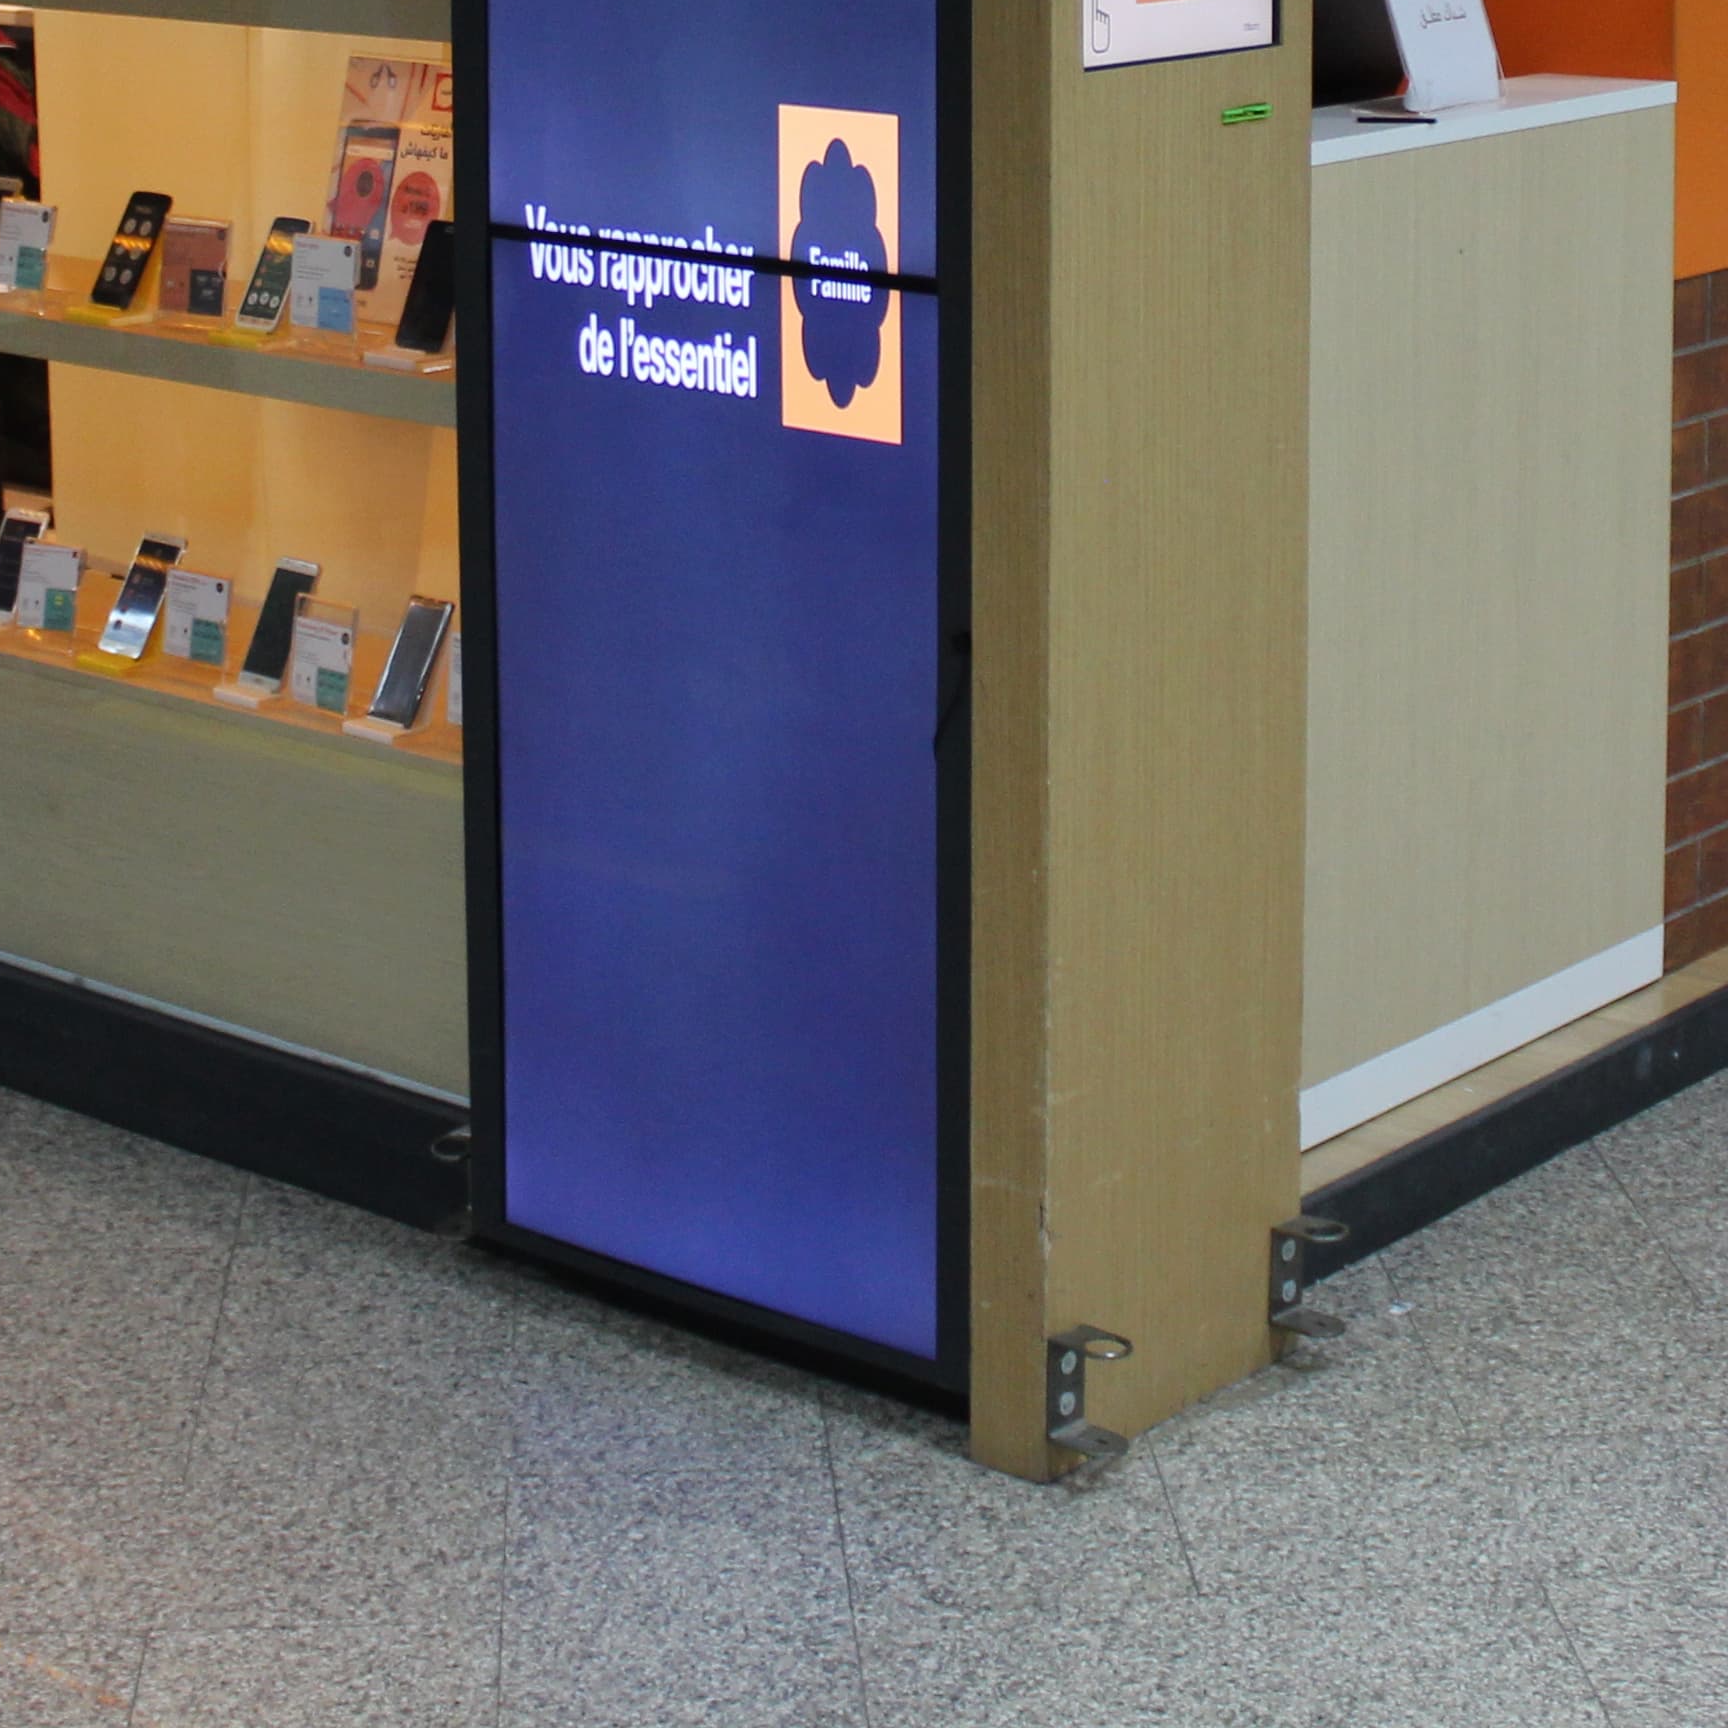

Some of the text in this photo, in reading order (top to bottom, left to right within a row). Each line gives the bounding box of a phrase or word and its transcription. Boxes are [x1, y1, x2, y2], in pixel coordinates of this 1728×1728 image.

[525, 203, 755, 309] Vous rapprocher
[578, 314, 758, 400] de l'essentiel
